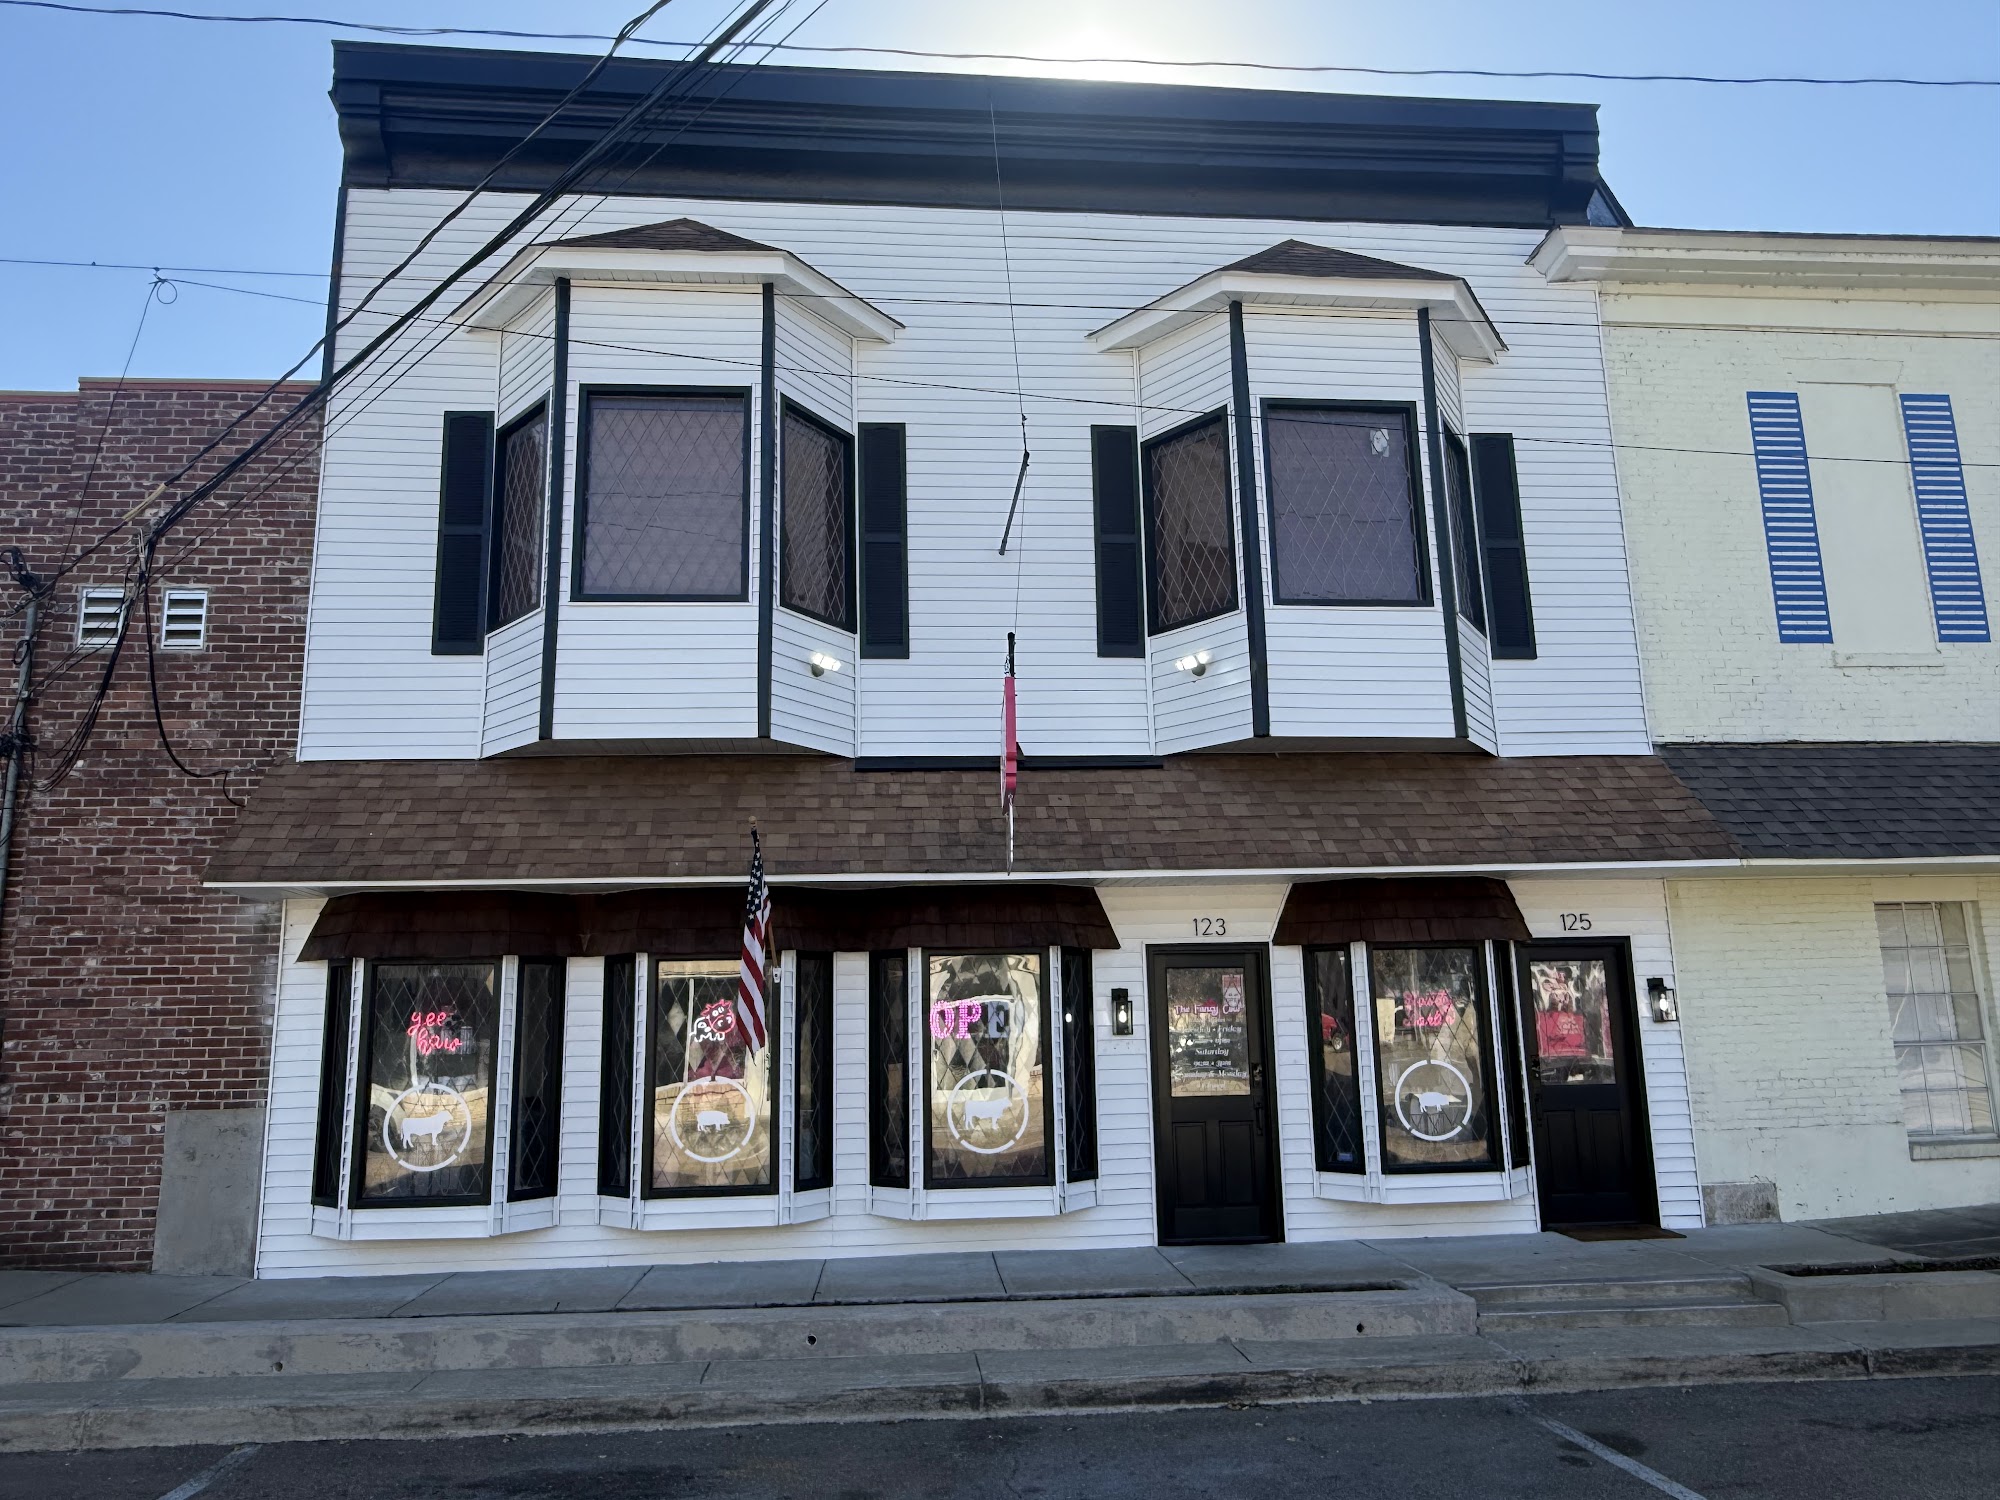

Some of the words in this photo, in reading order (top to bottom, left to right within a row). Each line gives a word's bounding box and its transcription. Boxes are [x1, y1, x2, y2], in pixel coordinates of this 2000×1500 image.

[1193, 917, 1226, 937] 123
[1559, 913, 1592, 931] 125
[1174, 1004, 1190, 1015] The
[1194, 1004, 1219, 1017] Fancy
[407, 1011, 447, 1037] yee
[417, 1027, 462, 1056] haw
[1194, 1047, 1230, 1057] Saturday
